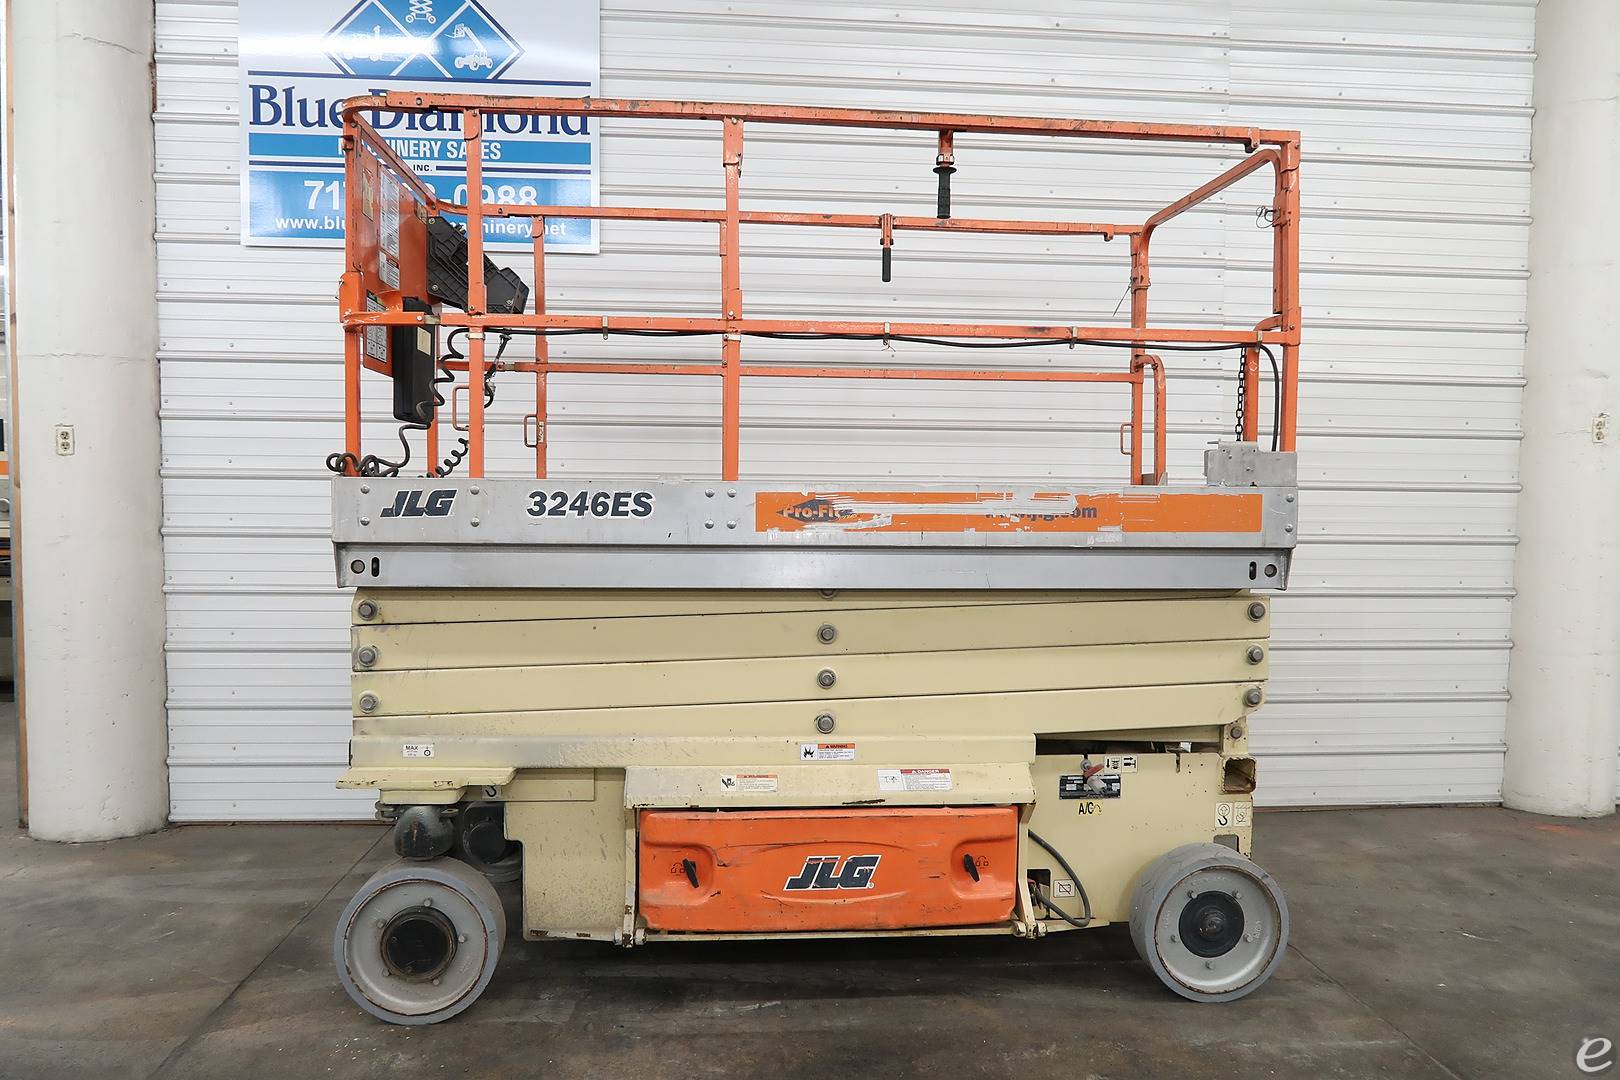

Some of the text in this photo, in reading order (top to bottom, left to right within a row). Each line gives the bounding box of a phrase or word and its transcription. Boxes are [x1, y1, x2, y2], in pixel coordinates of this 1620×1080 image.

[338, 138, 502, 160] INERY SAES
[413, 164, 433, 172] INC.
[380, 489, 653, 517] JLG 3246ES
[1078, 801, 1094, 815] A/C
[783, 855, 882, 891] JLG
